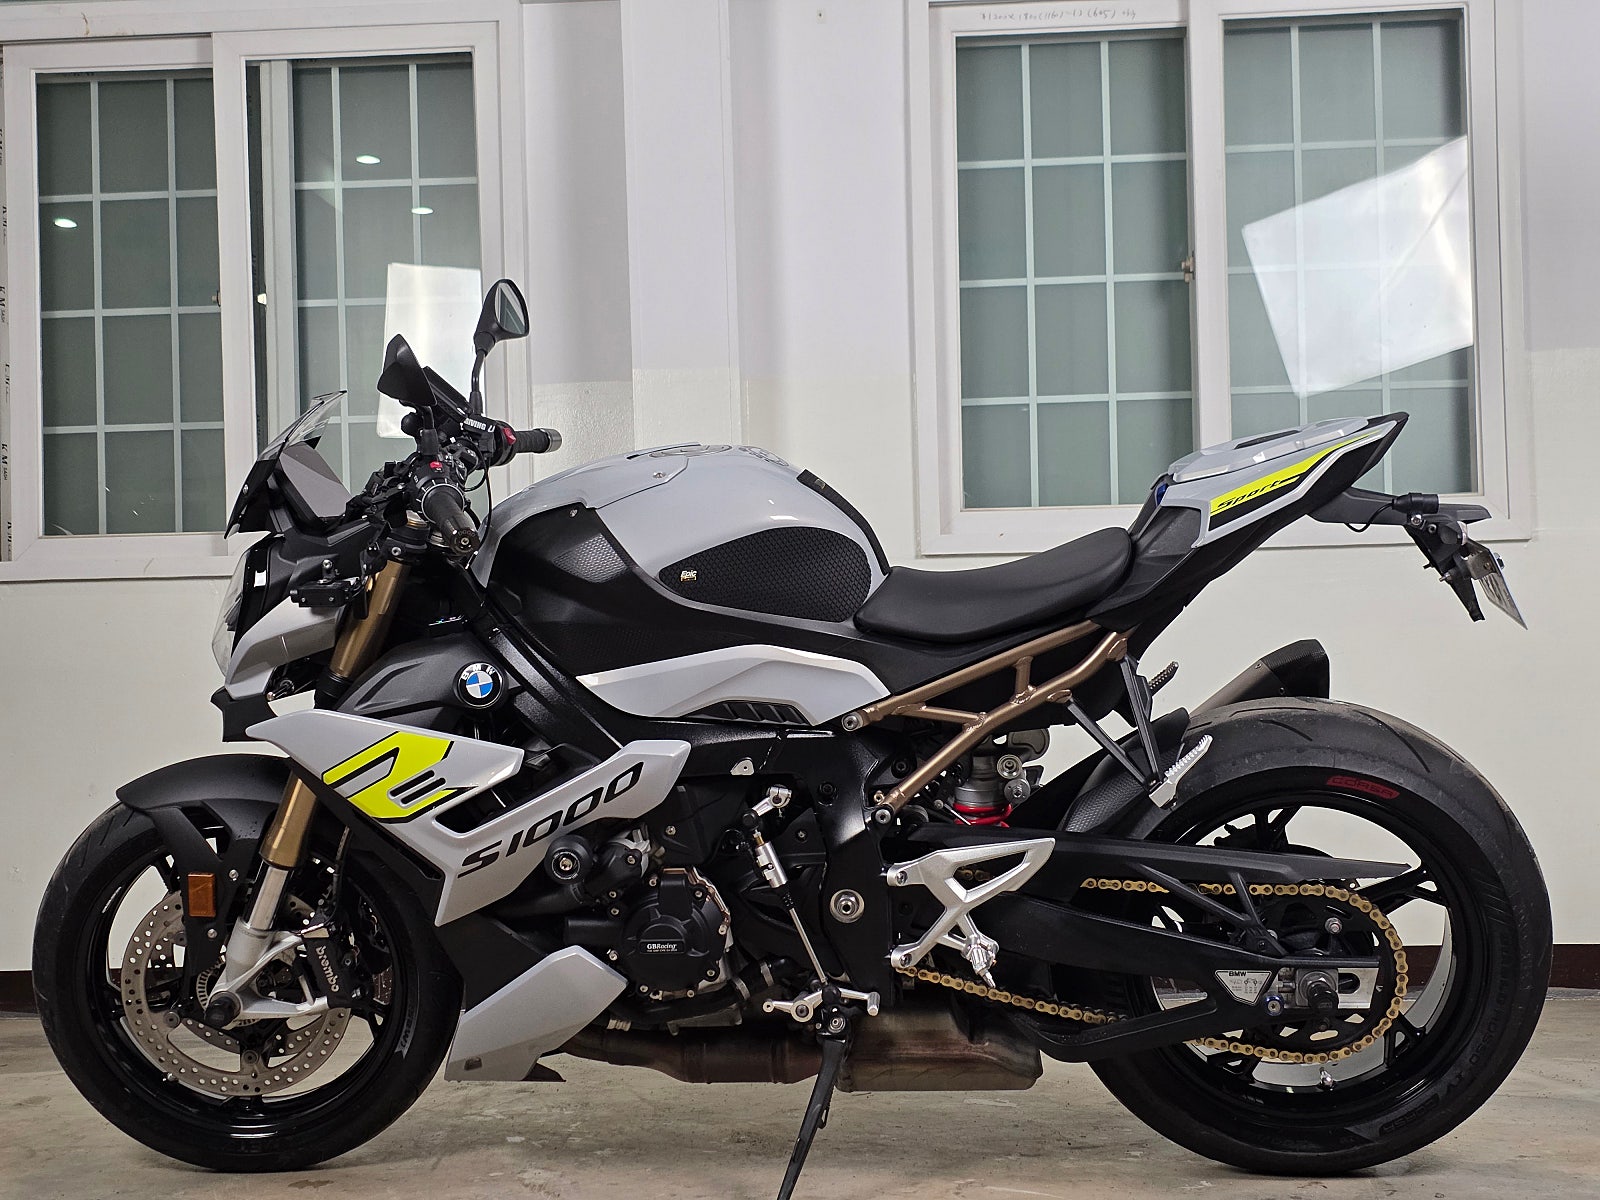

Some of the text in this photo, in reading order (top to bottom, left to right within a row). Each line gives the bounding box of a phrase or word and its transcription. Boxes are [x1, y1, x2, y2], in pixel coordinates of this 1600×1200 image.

[460, 663, 497, 681] BMW
[457, 761, 645, 879] S1000
[315, 945, 340, 992] brembo
